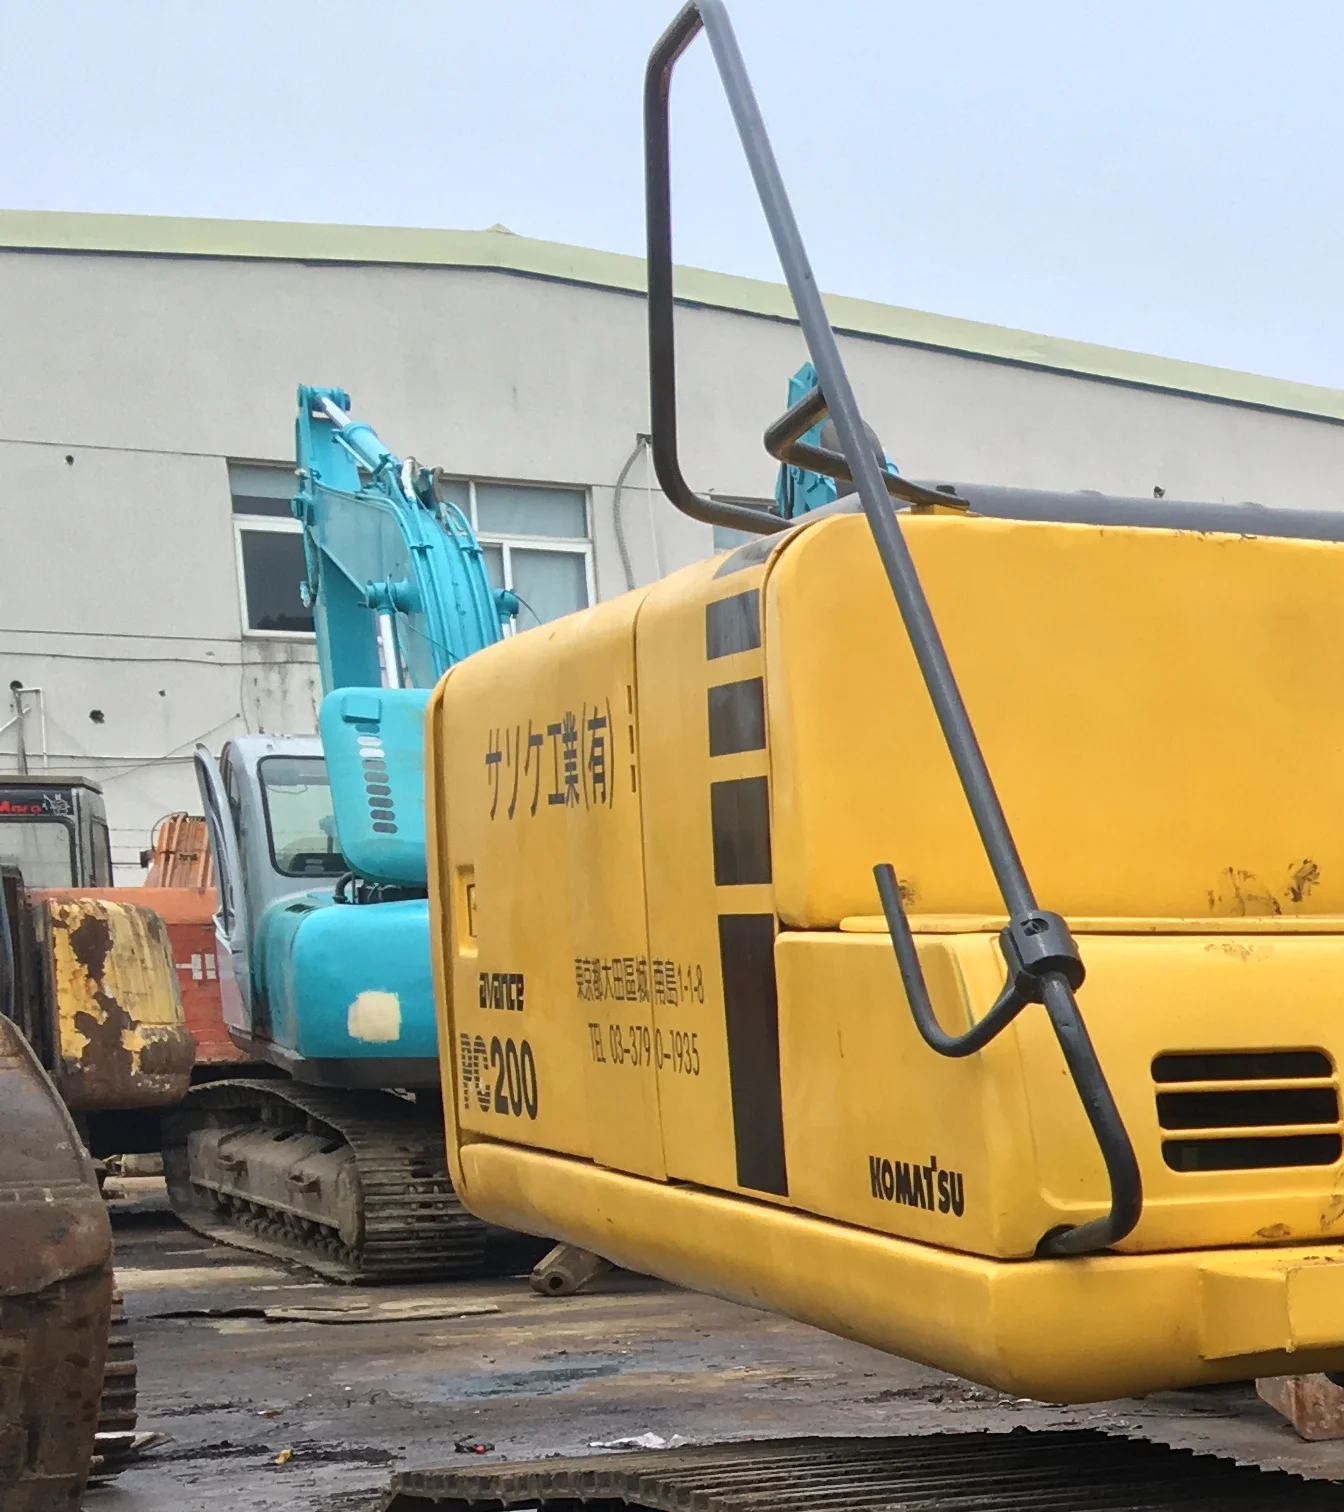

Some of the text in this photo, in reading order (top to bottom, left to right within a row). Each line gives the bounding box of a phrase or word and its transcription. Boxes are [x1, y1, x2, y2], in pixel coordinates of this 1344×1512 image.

[460, 1032, 538, 1121] PC200
[588, 1022, 700, 1076] TEL 03-3790-1935
[869, 1155, 965, 1218] KOMATSU
